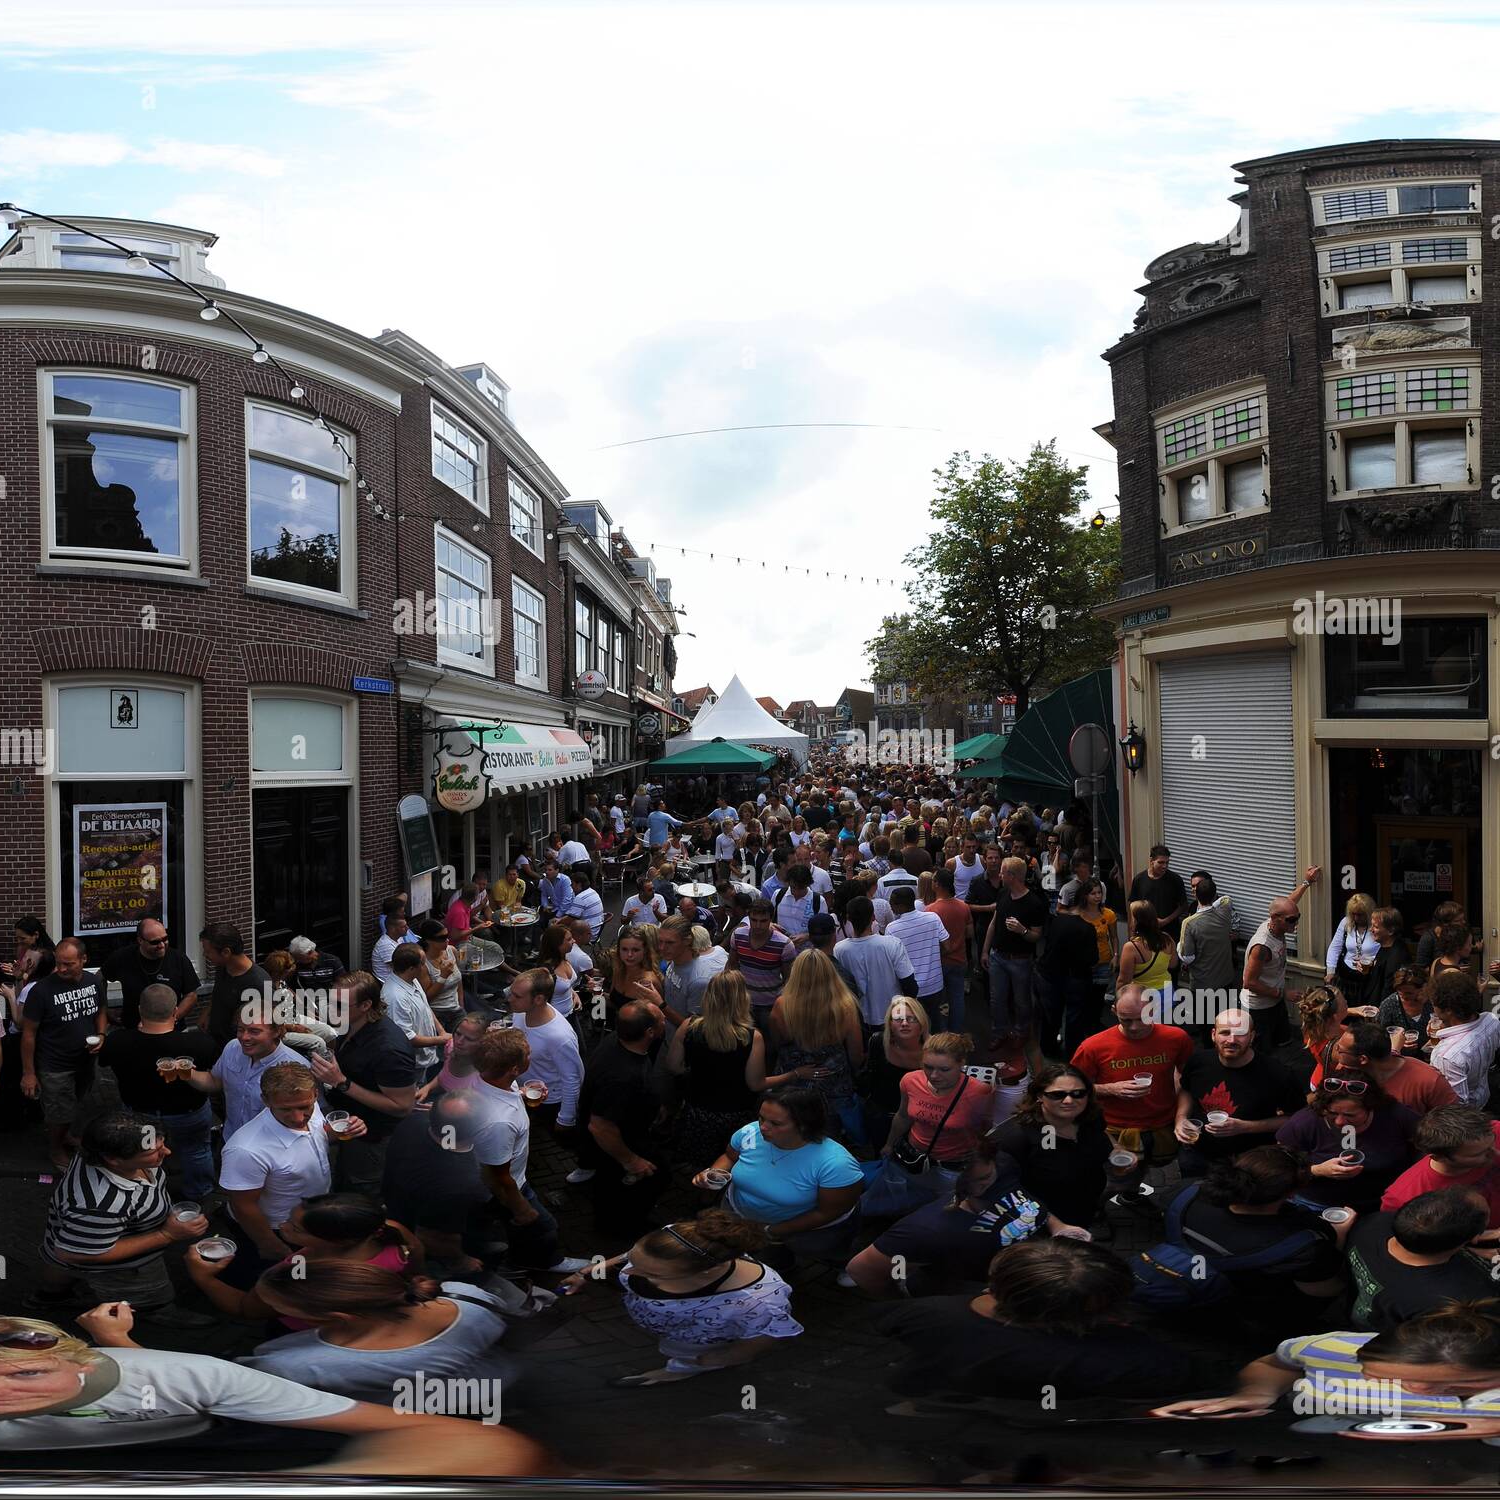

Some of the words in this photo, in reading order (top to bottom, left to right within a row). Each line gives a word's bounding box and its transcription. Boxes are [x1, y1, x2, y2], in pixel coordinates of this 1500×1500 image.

[1223, 539, 1257, 557] NO
[439, 775, 479, 792] Grolsch
[81, 821, 99, 832] DE
[102, 818, 161, 831] BEIAARD
[82, 842, 158, 854] Recessie-actie
[83, 879, 125, 889] SPARE
[99, 899, 147, 910] €11.00
[65, 1003, 74, 1014] &
[74, 998, 96, 1011] FITCH
[62, 1012, 80, 1022] NEW
[1109, 1052, 1170, 1070] tomaat
